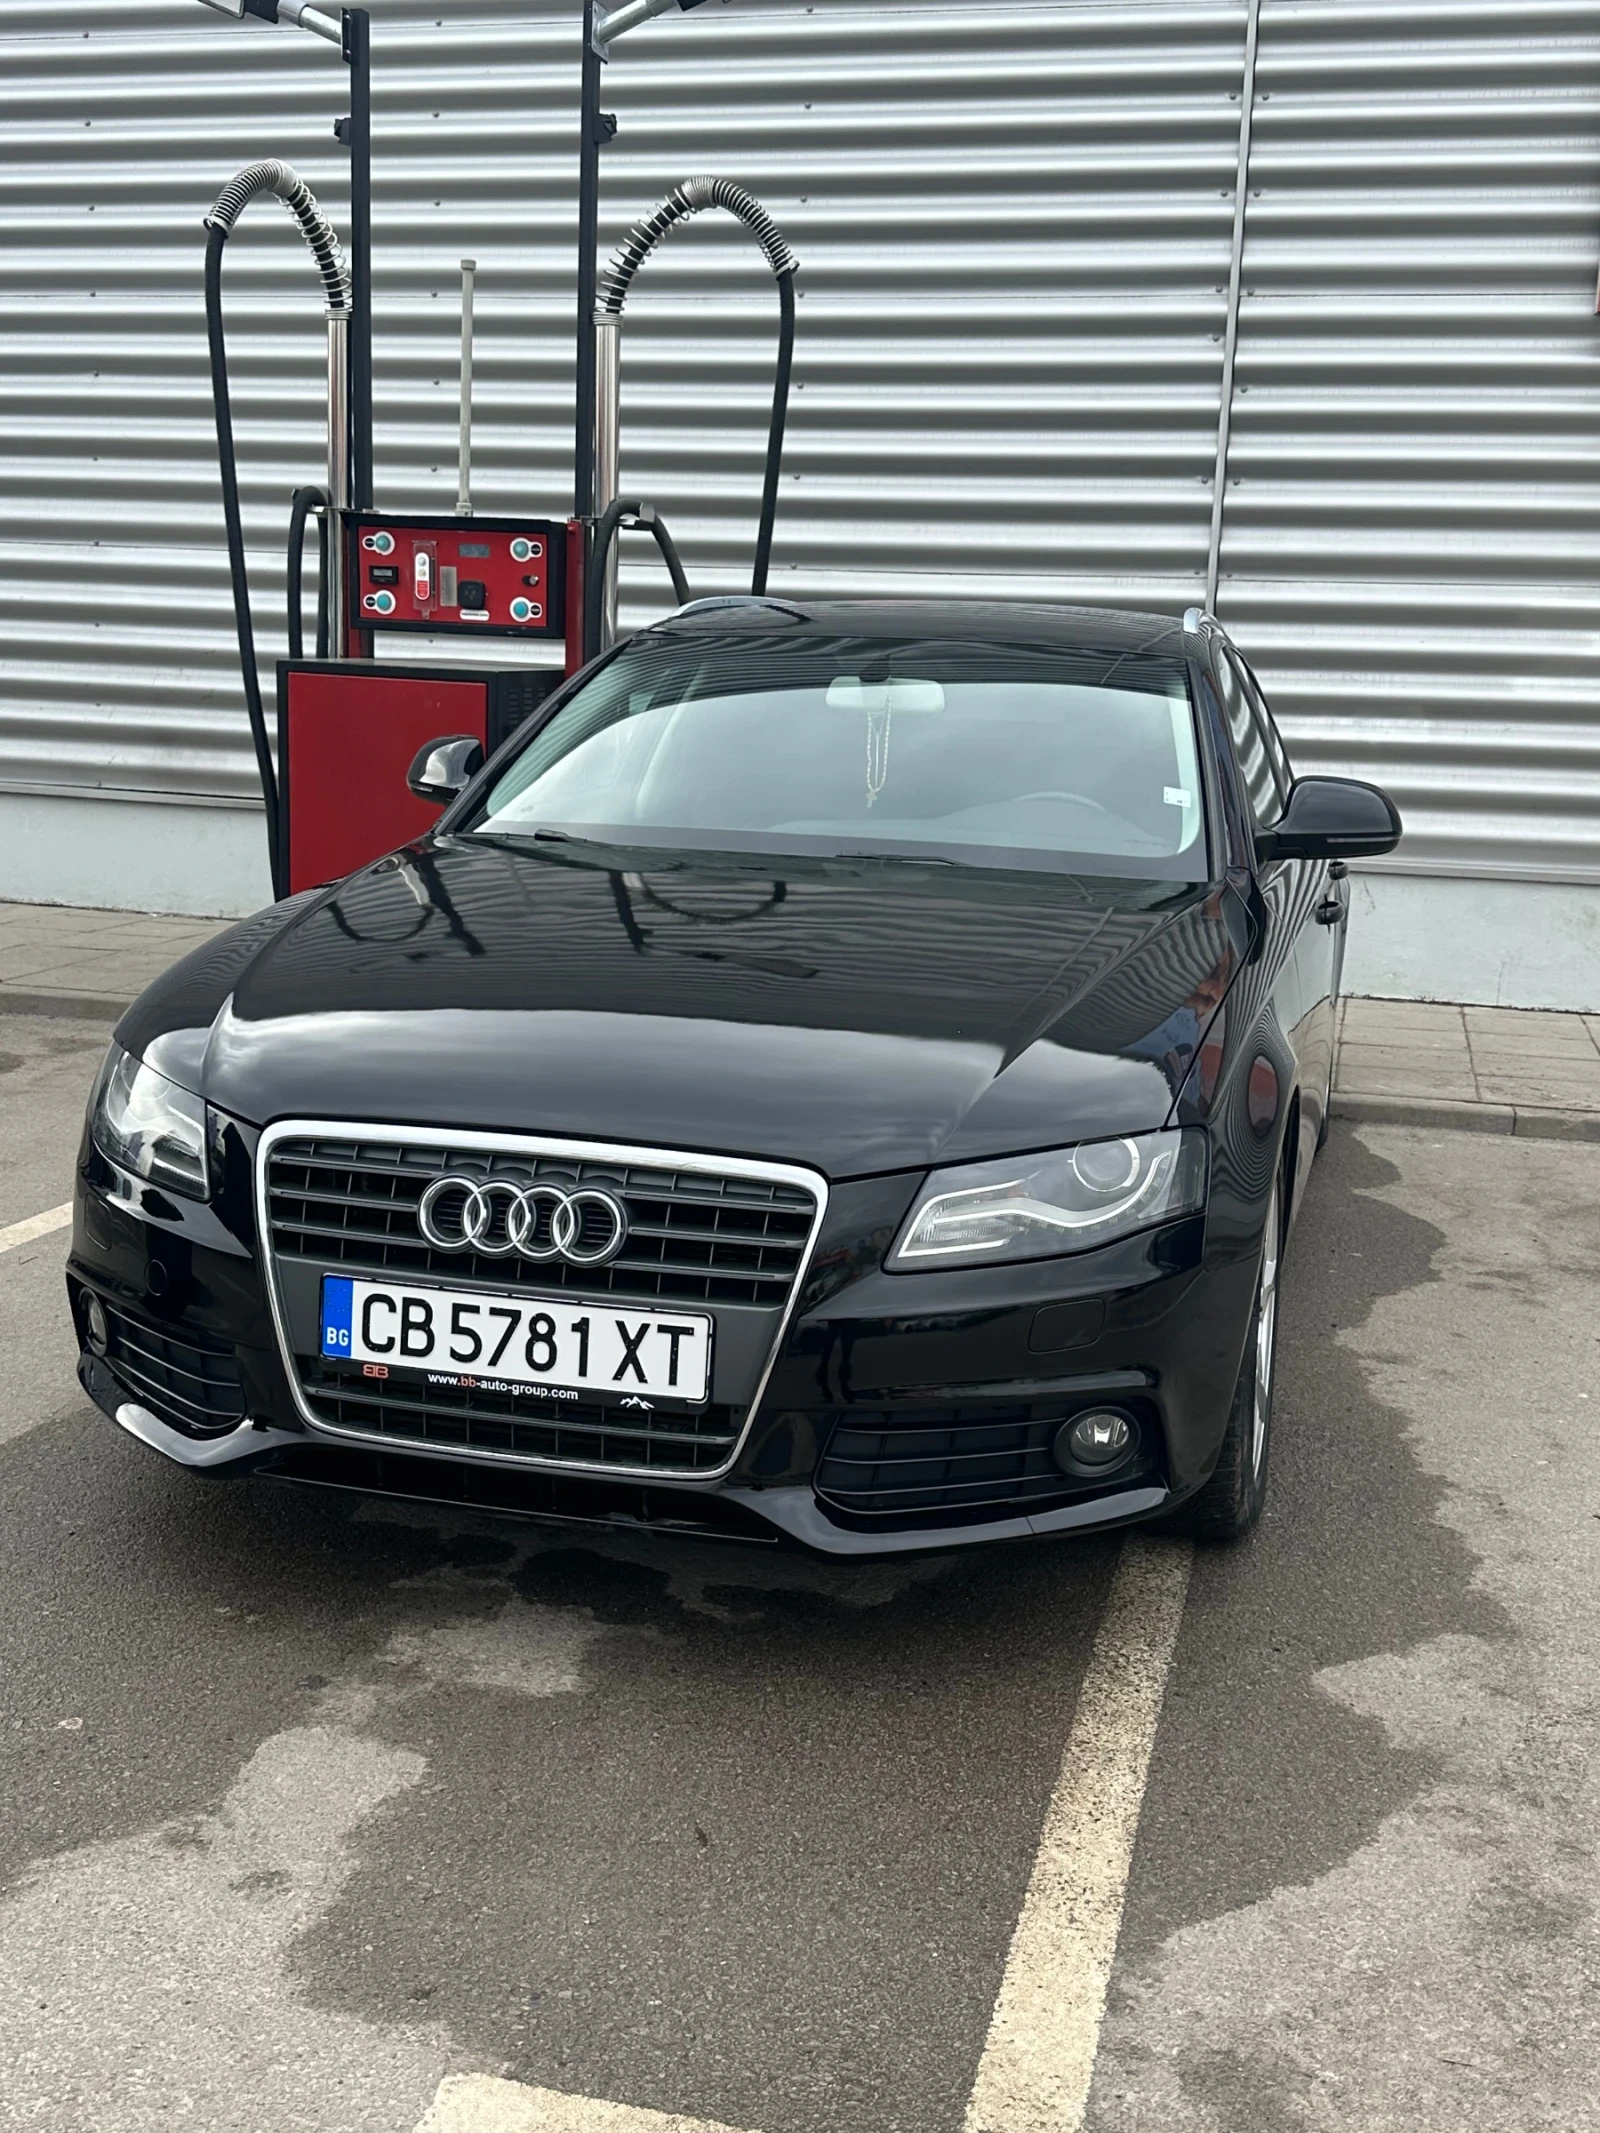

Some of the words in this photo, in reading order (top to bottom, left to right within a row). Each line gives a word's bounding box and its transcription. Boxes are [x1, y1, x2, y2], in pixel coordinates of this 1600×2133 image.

[326, 1327, 349, 1346] BG
[362, 1293, 435, 1357] CB
[450, 1302, 590, 1378] 5781
[612, 1319, 695, 1386] XT
[427, 1373, 579, 1400] www.bb-auto-group.com
